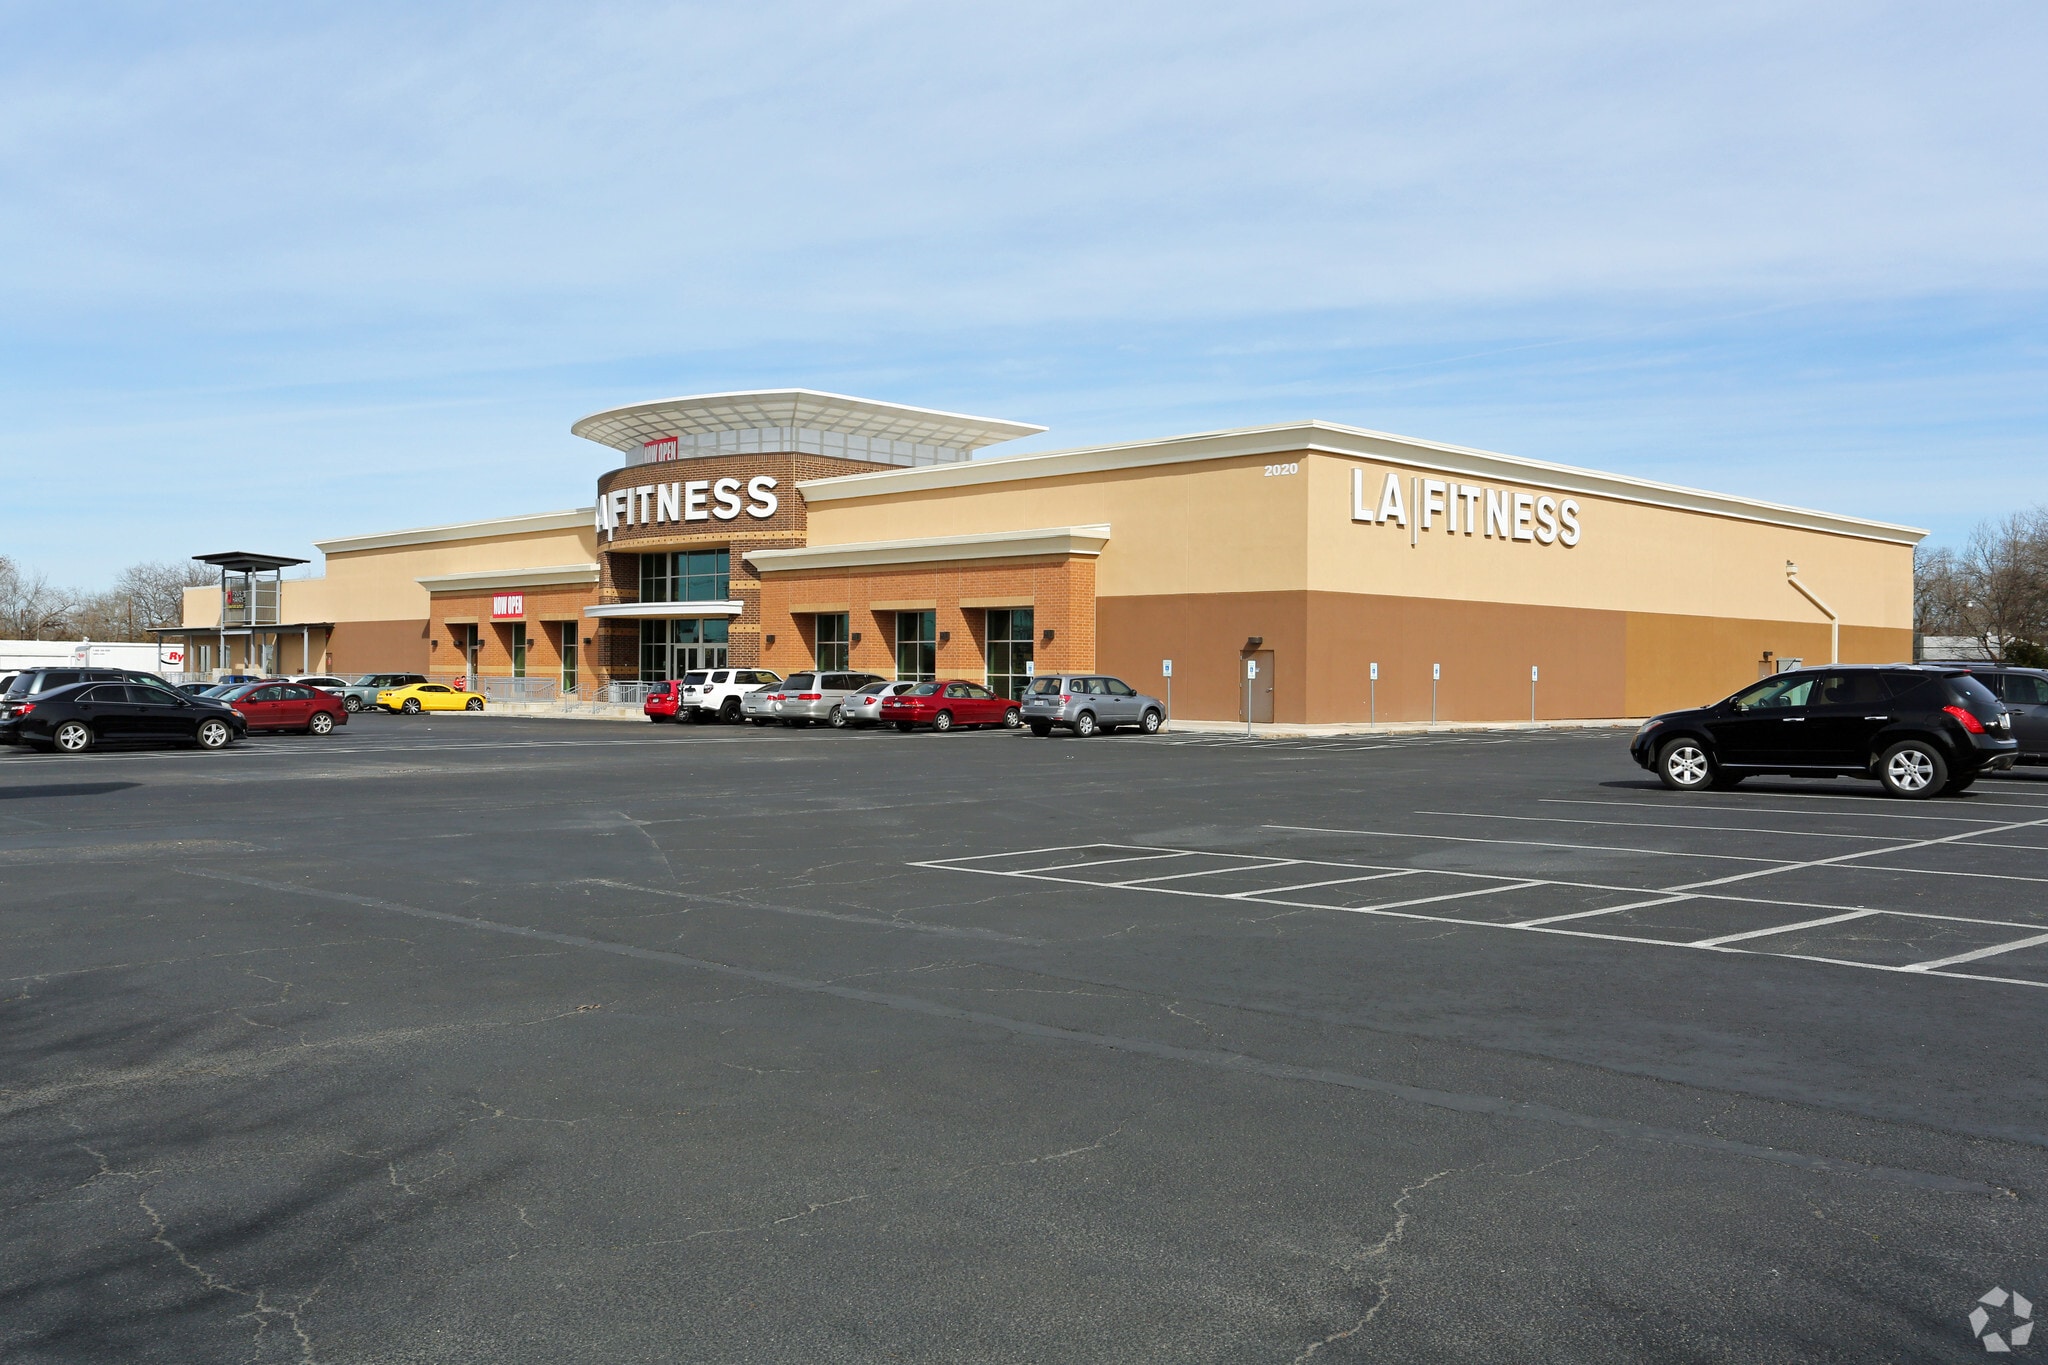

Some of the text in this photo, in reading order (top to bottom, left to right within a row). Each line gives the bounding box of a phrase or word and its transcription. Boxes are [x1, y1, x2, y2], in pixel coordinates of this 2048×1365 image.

[659, 440, 677, 462] OPEN
[1264, 462, 1299, 477] 2020
[611, 475, 779, 528] FITNESS
[1351, 467, 1581, 546] LA FITNESS
[493, 595, 523, 615] NOW OPEN
